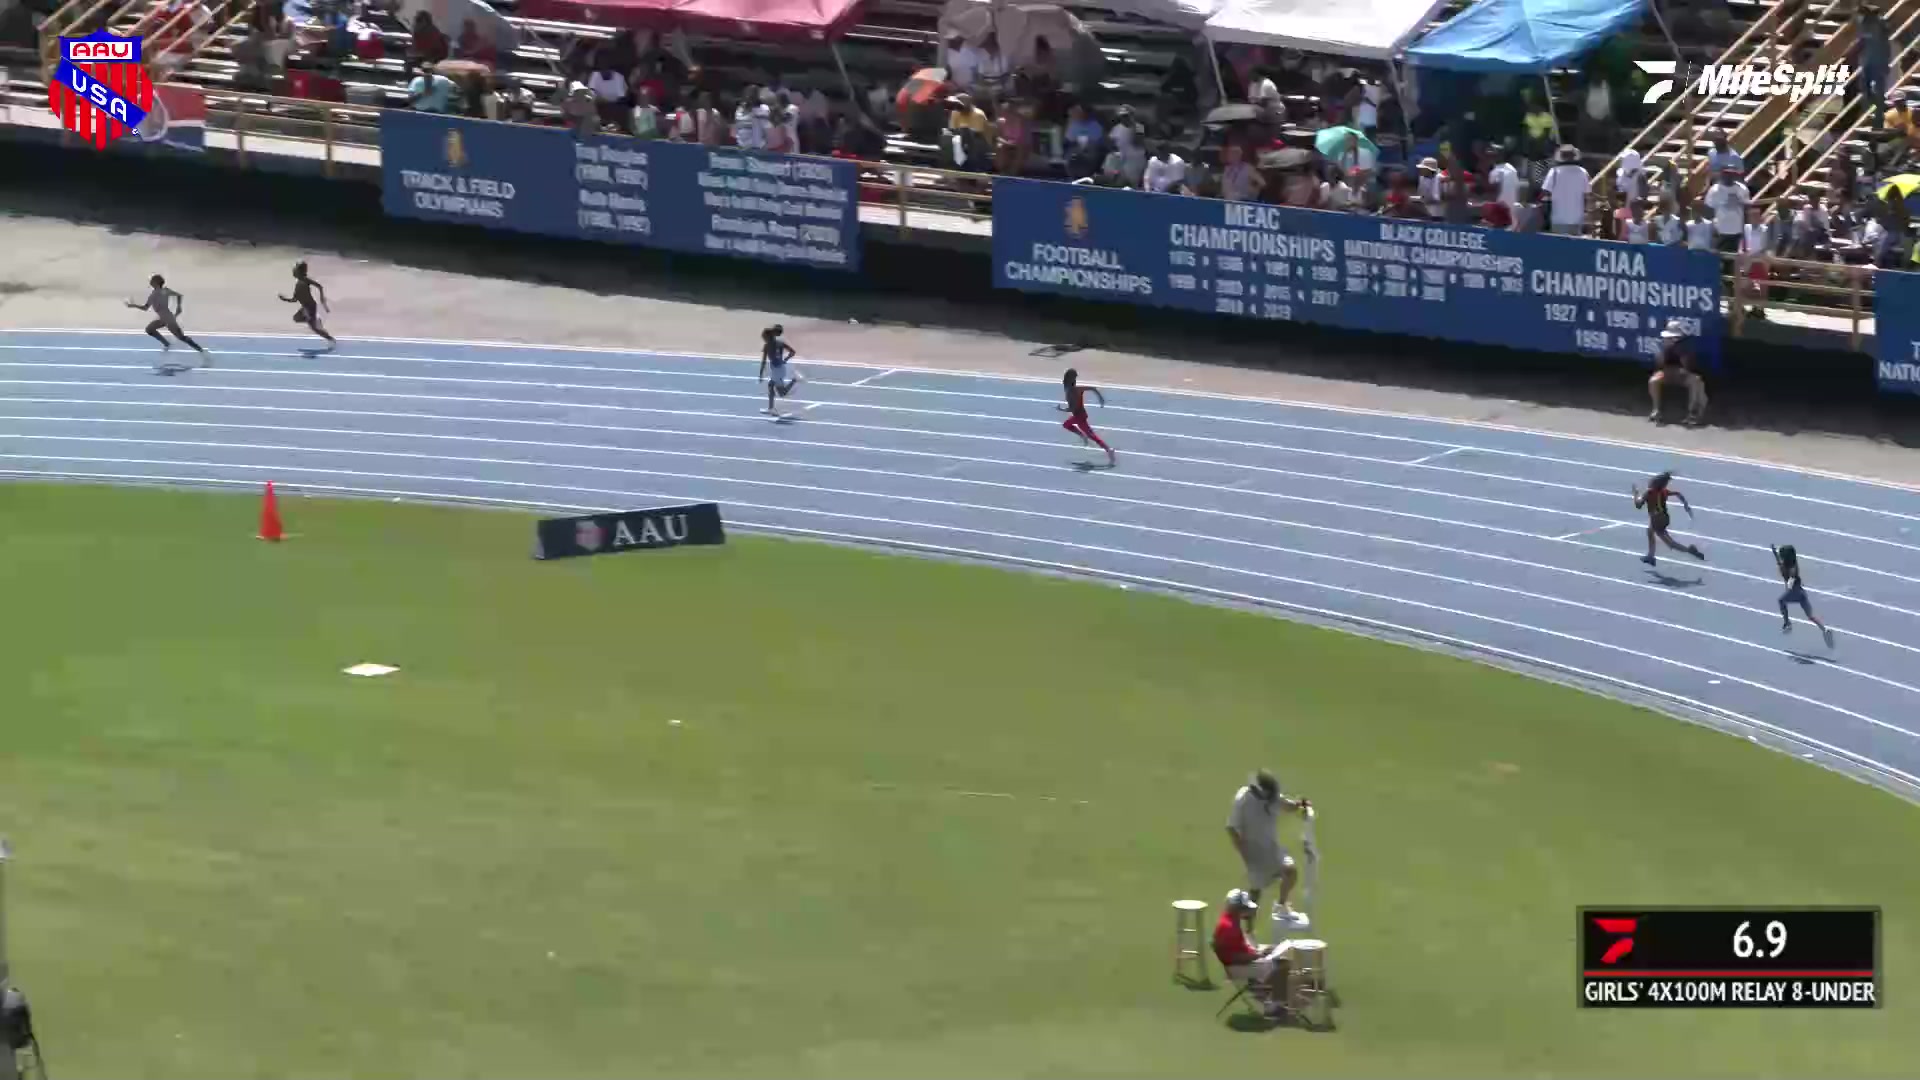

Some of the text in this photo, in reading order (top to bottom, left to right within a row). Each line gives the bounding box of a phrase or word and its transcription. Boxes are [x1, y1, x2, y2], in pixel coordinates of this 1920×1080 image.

[400, 169, 454, 193] TRACK
[469, 178, 516, 200] FIELD
[1223, 202, 1281, 231] MEAC
[1169, 223, 1337, 263] CHAMPIONSHIPS
[1379, 223, 1488, 250] BLACK COLLEGE
[1032, 242, 1125, 271] FOOTBALL
[1410, 246, 1524, 276] CHAMPIONSHIPS
[1595, 248, 1647, 278] CIAA
[1004, 260, 1154, 295] CHAMPIONSHIPS
[1531, 269, 1715, 313] CHAMPIONSHIPS
[1543, 302, 1577, 323] 1927
[613, 513, 689, 546] AAU
